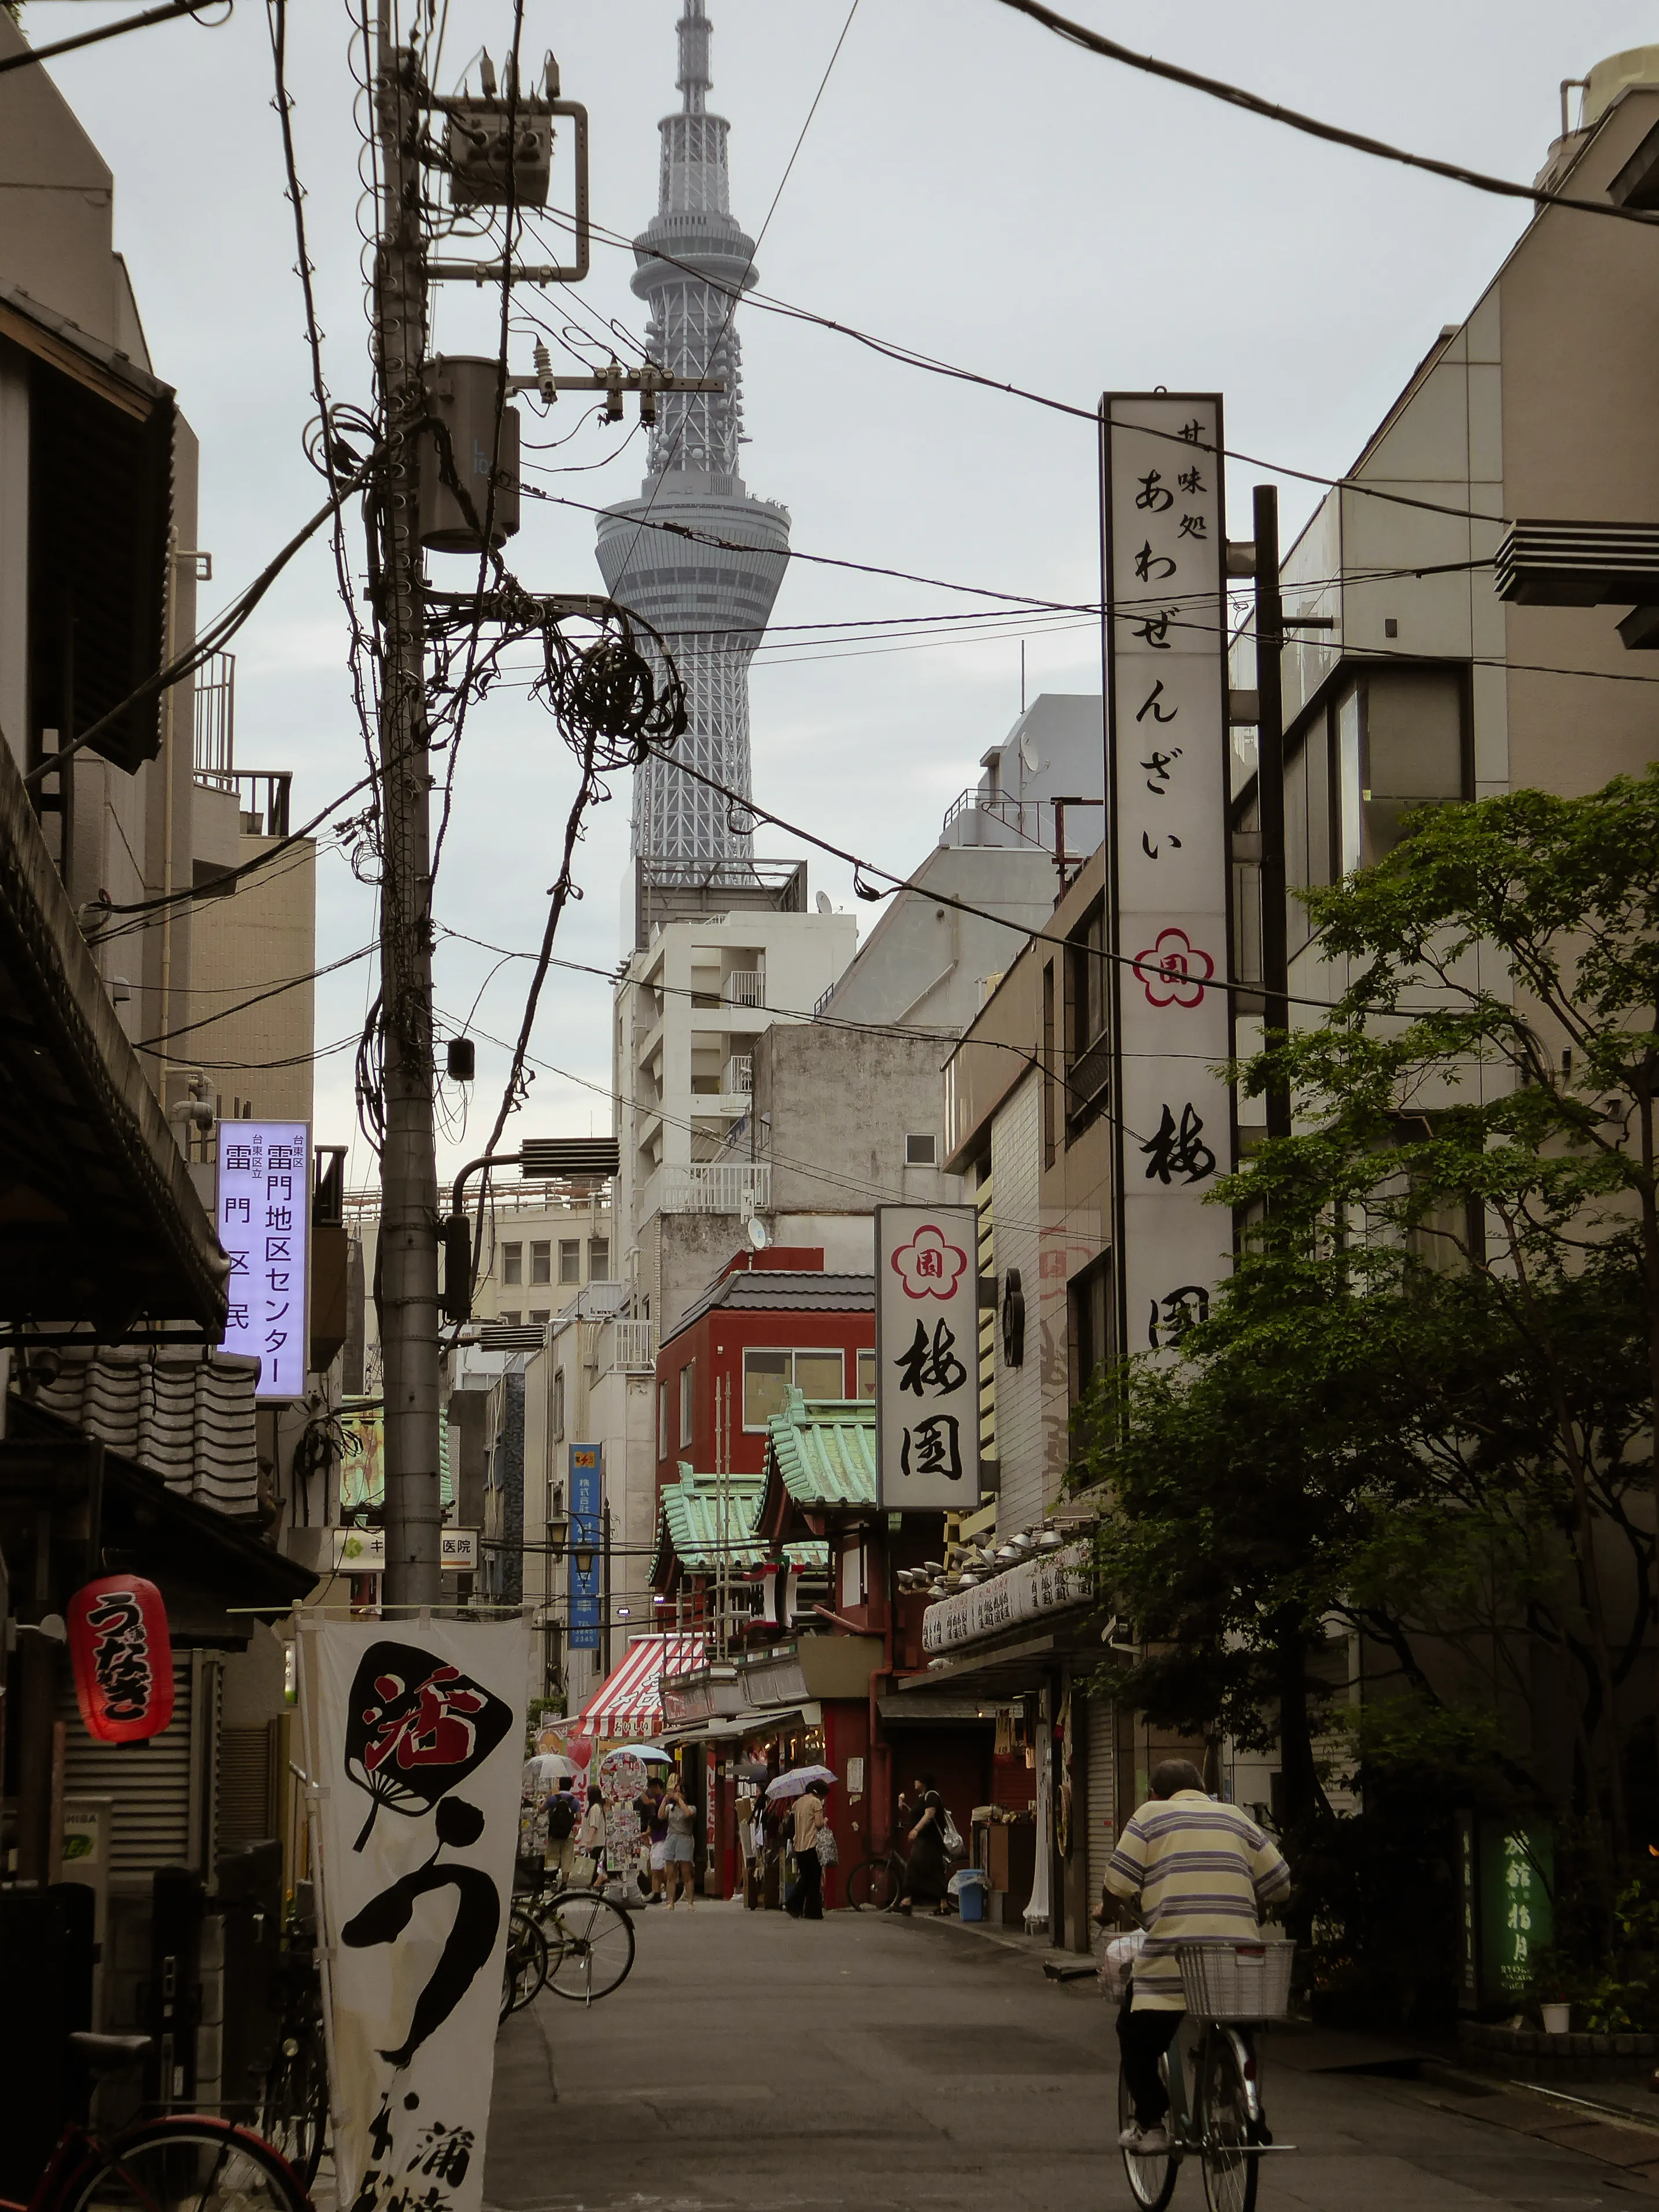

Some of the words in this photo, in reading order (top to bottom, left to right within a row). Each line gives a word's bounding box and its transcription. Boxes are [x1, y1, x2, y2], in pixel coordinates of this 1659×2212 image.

[1177, 419, 1207, 540] 甘味処
[1131, 469, 1184, 860] あわぜんざい
[252, 1134, 263, 1179] 台東区立
[293, 1135, 304, 1168] 台東区
[264, 1144, 293, 1383] 雷門地区センター
[86, 1591, 153, 1723] うなぎ
[614, 1721, 649, 1732] おいしい
